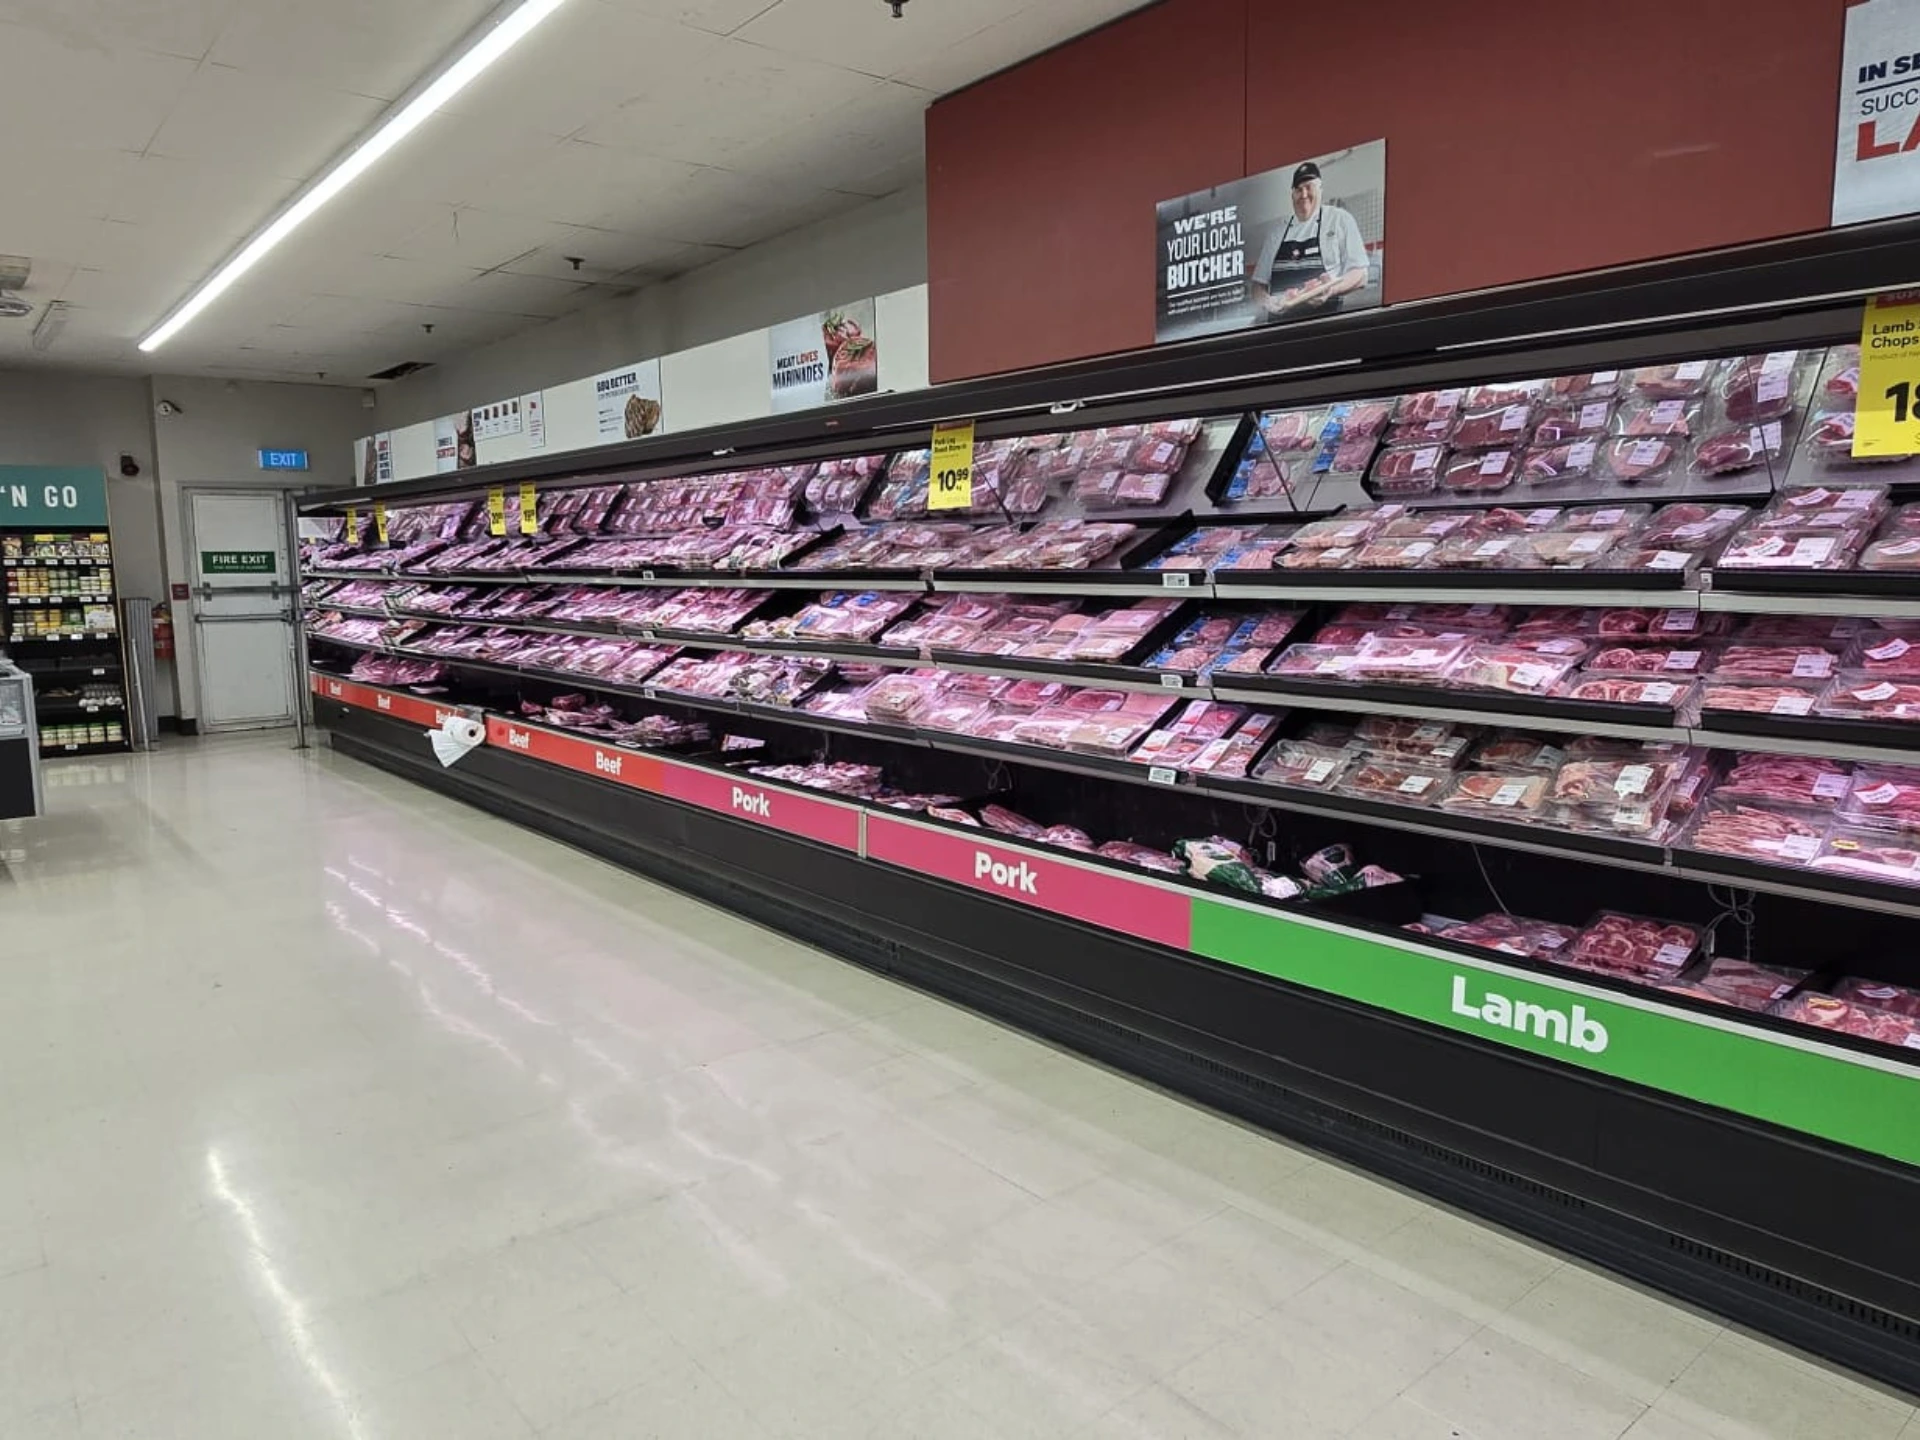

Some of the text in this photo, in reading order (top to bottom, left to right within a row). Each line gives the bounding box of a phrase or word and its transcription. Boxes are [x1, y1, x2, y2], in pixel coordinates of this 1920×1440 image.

[1858, 60, 1888, 84] IN
[1174, 205, 1238, 235] WE'RE
[1166, 222, 1246, 263] YOUR LOCAL
[1166, 249, 1245, 291] BUTCHER
[1872, 320, 1915, 335] Lamb
[1871, 335, 1919, 349] Chops
[776, 350, 819, 370] MEAT LOVES
[772, 362, 823, 390] MARINADES
[1885, 381, 1920, 422] 1
[270, 452, 296, 466] EXIT
[44, 485, 77, 508] GO
[212, 554, 268, 564] FIRE EXIT
[508, 728, 530, 749] Beef
[595, 751, 622, 776] Beef
[731, 786, 771, 817] Pork
[974, 851, 1037, 895] Pork
[1451, 974, 1609, 1054] Lamb
